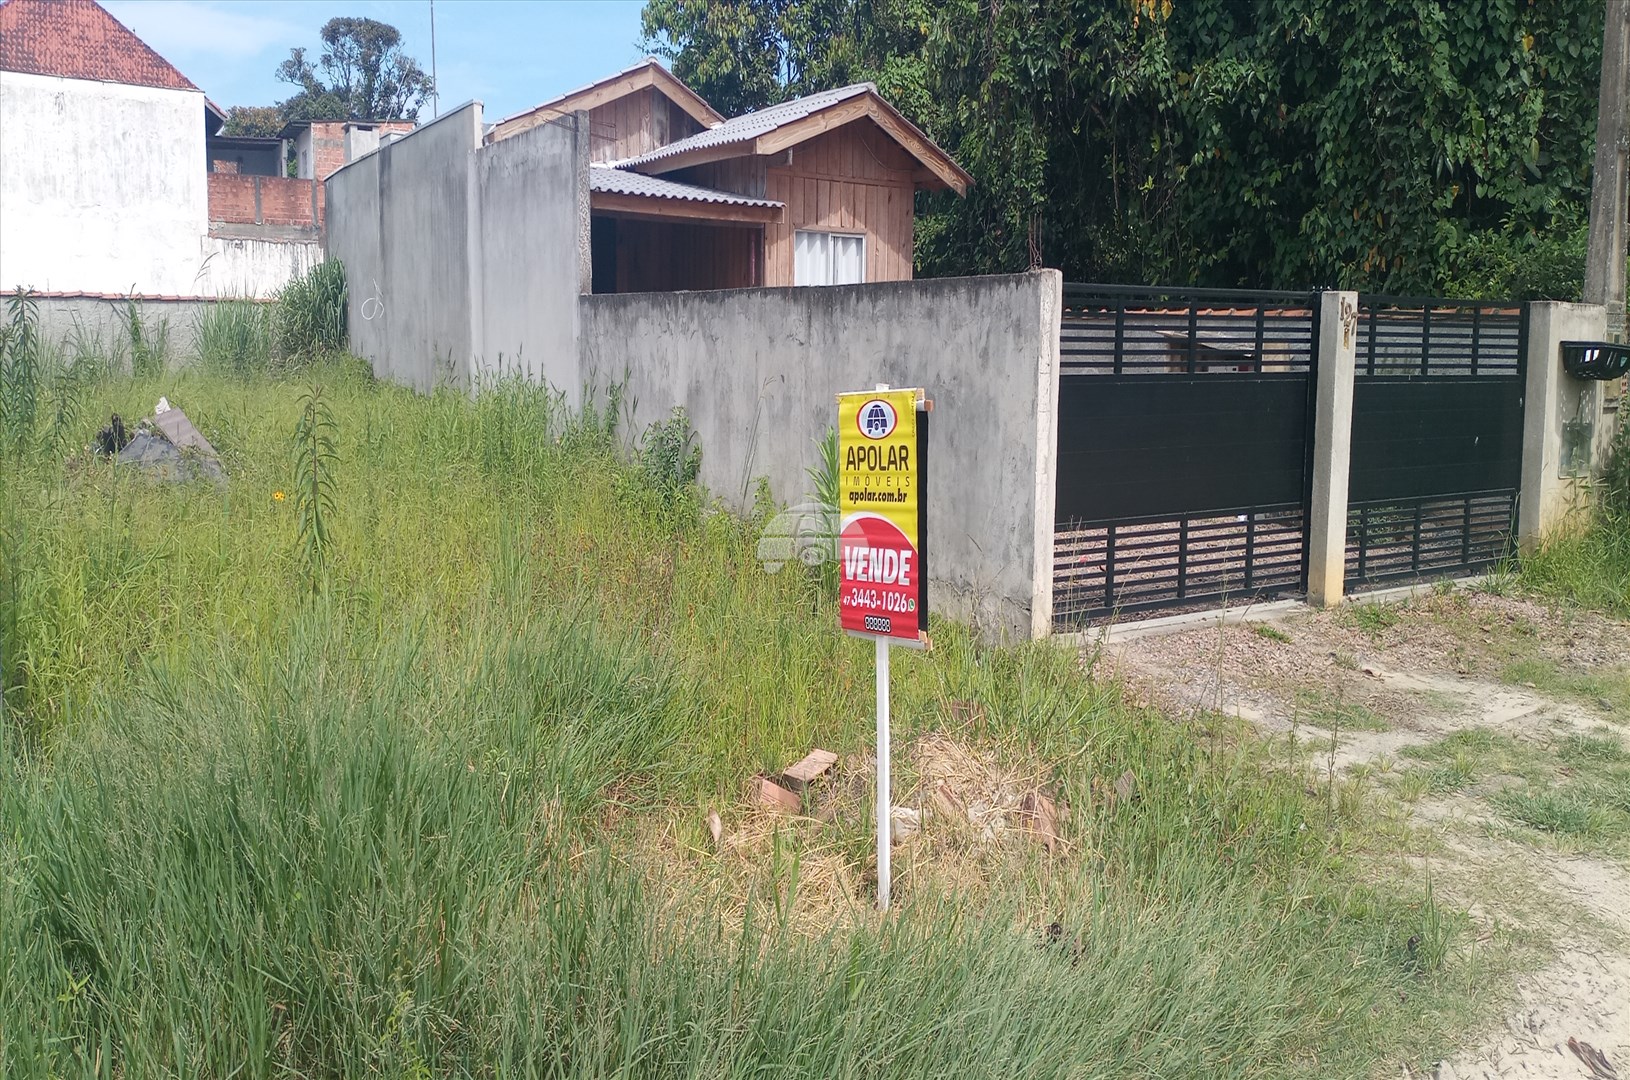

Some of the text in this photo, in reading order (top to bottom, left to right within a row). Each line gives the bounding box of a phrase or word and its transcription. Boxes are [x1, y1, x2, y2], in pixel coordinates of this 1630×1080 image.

[846, 445, 909, 471] APOLAR
[846, 474, 910, 487] IMÓVEIS
[849, 488, 907, 504] apolar.com.br
[844, 546, 912, 585] VENDE
[843, 588, 907, 613] 47 3443-1026
